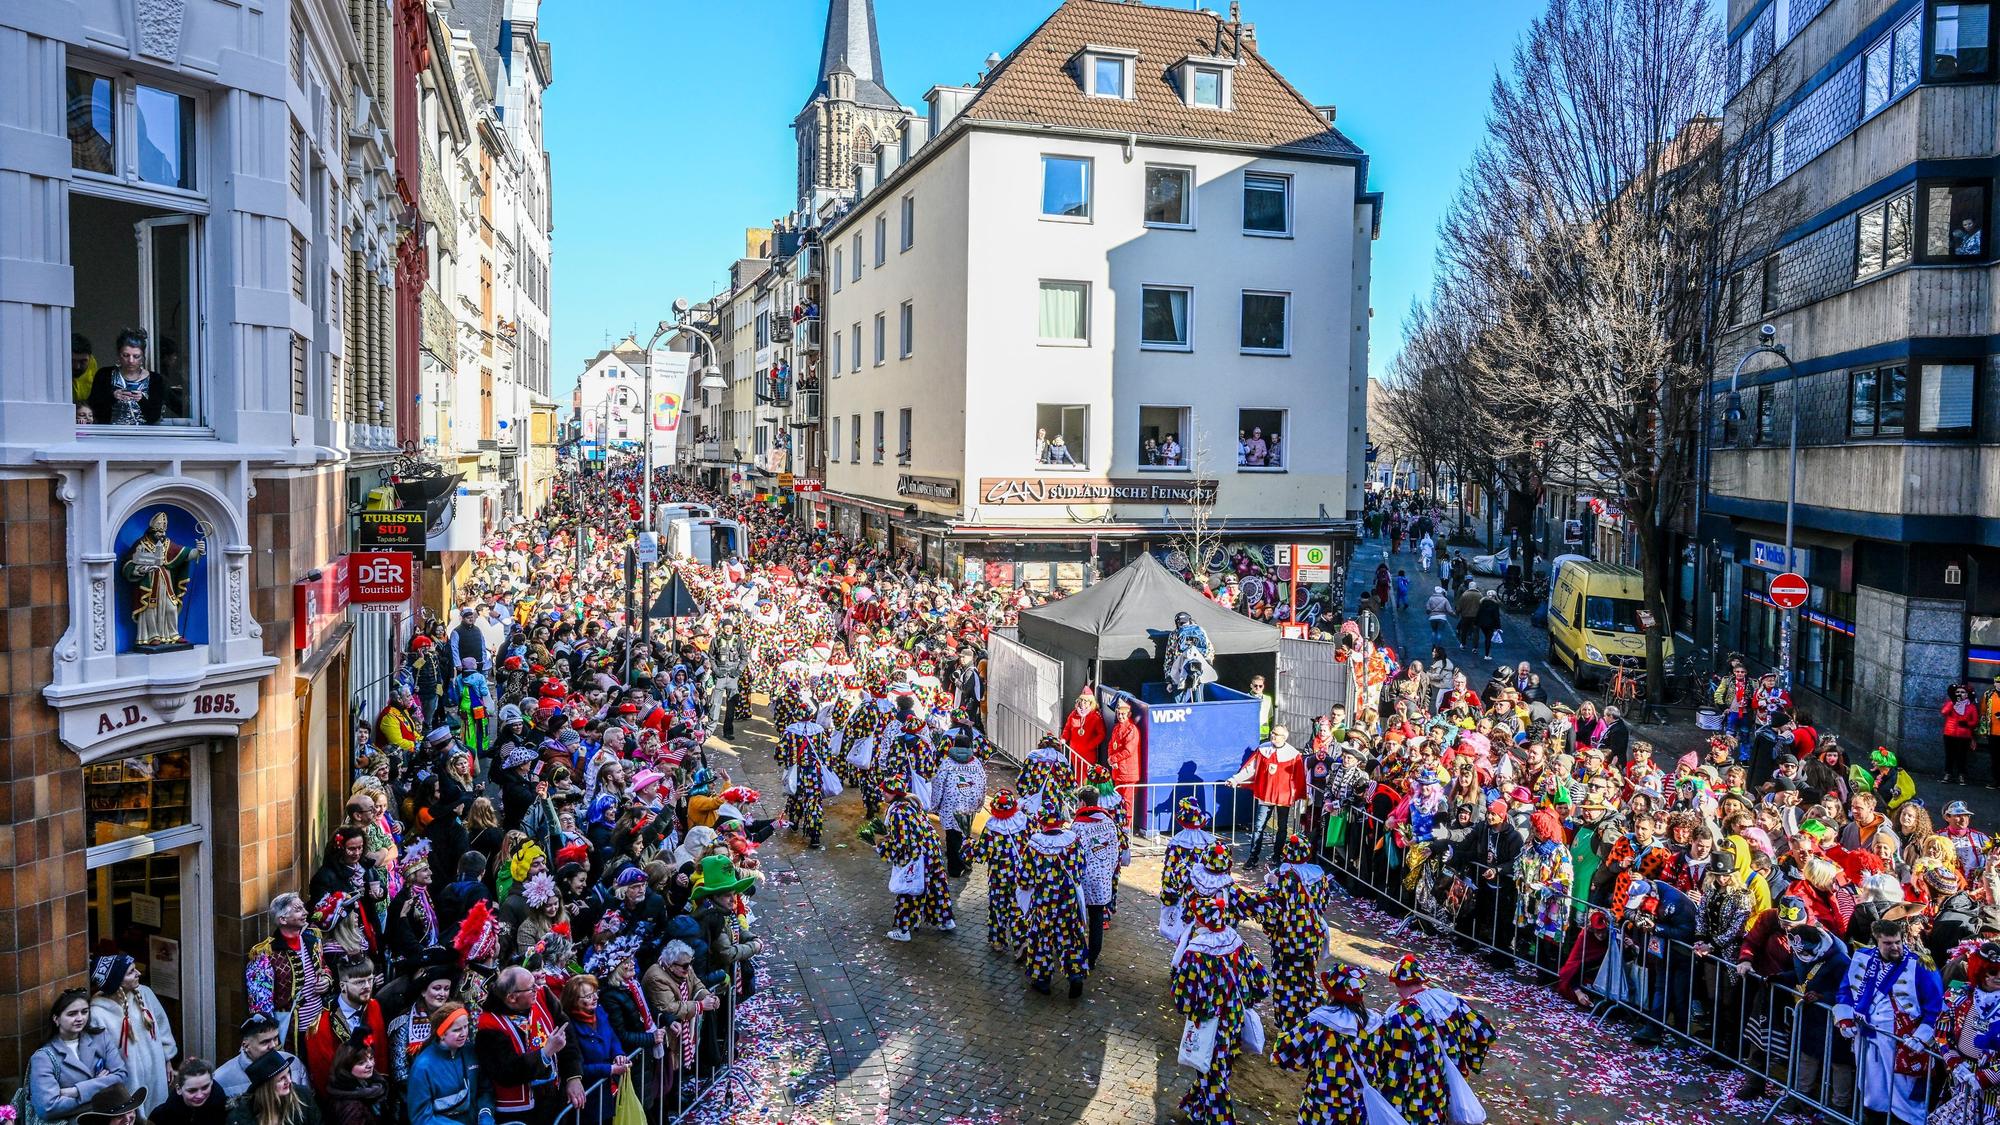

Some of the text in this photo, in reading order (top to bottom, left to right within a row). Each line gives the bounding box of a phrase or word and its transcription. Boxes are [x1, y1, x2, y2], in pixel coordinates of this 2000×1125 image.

[1050, 484, 1147, 499] SÜDLÄNDISCHE
[1151, 485, 1213, 499] FEINKOST
[363, 513, 423, 523] TURISTA
[377, 535, 409, 543] Tapas-Bar
[359, 565, 404, 584] DER
[360, 585, 404, 594] Touristik
[361, 603, 399, 612] Partner
[97, 693, 240, 735] A.D. 1895.
[1152, 709, 1187, 723] WDR
